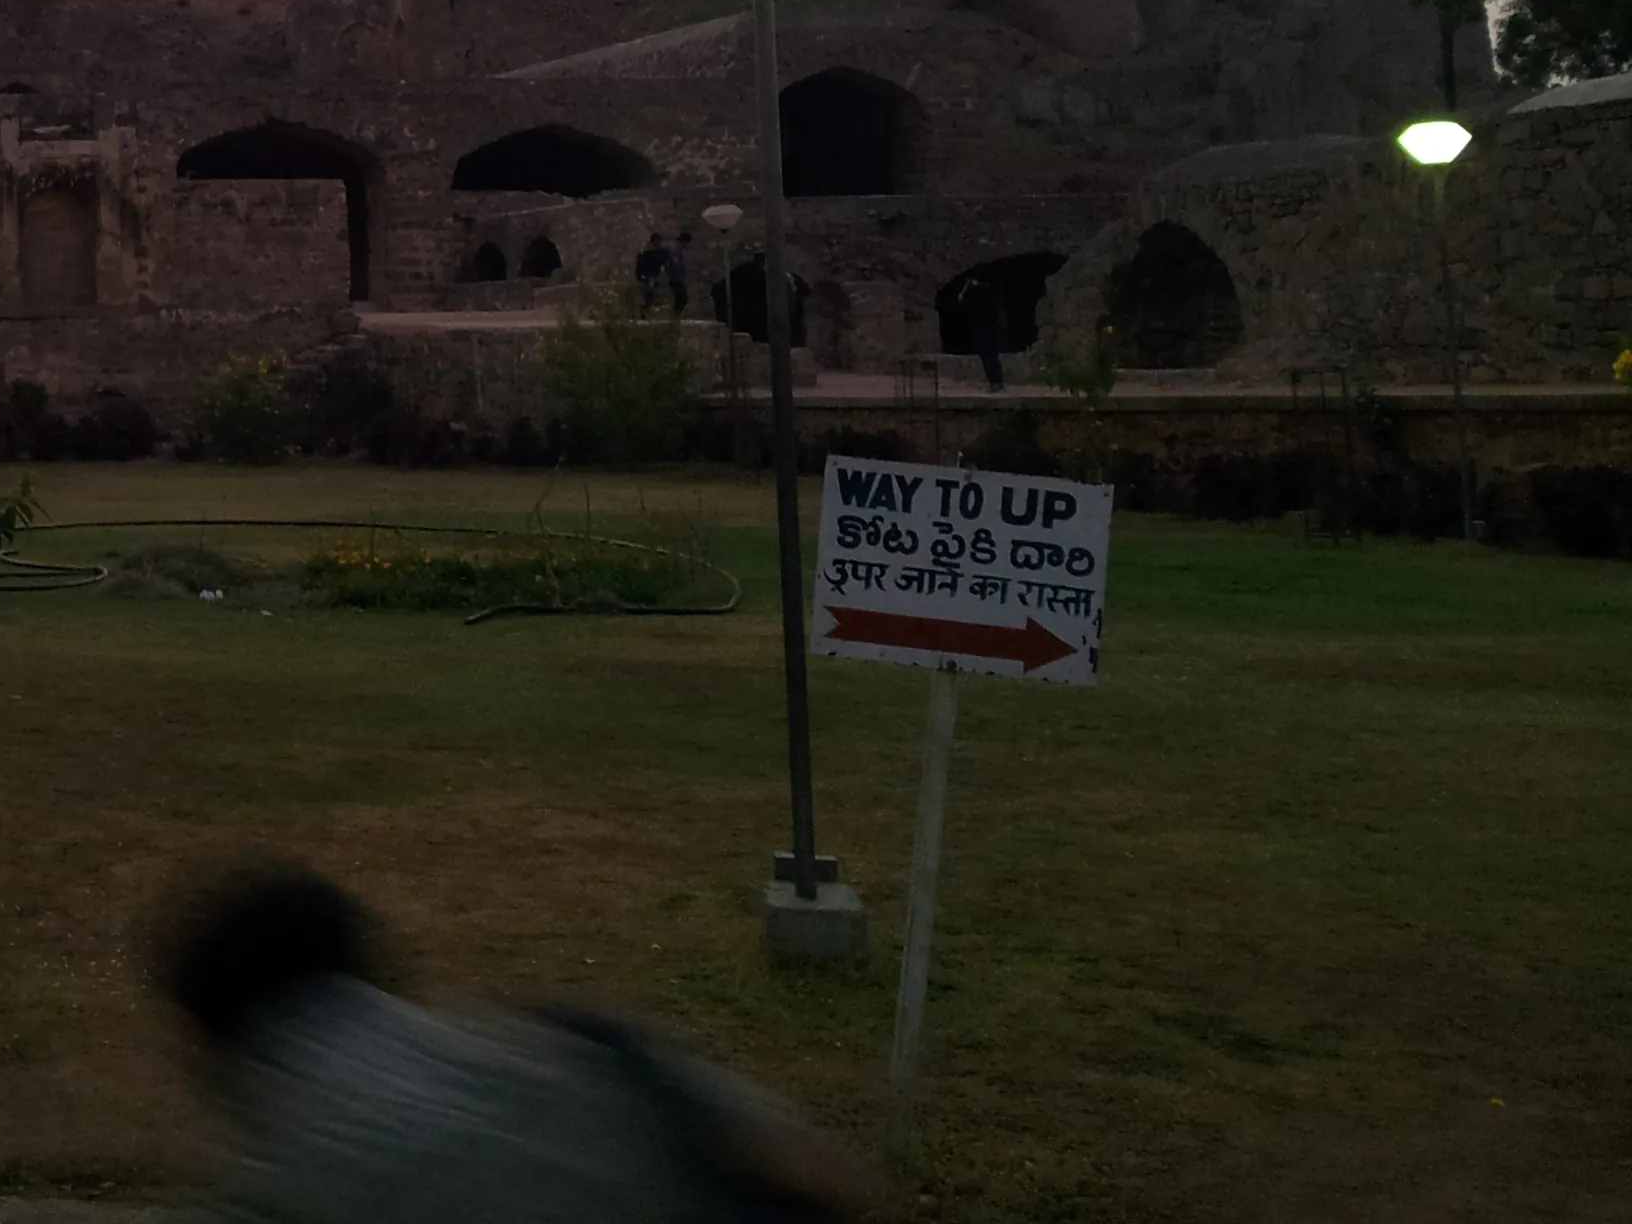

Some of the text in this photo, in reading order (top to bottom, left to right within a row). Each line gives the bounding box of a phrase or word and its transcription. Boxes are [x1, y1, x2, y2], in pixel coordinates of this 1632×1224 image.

[836, 467, 1078, 529] WAY TO UP
[968, 574, 1013, 605] का
[1017, 579, 1096, 618] रास्ता
